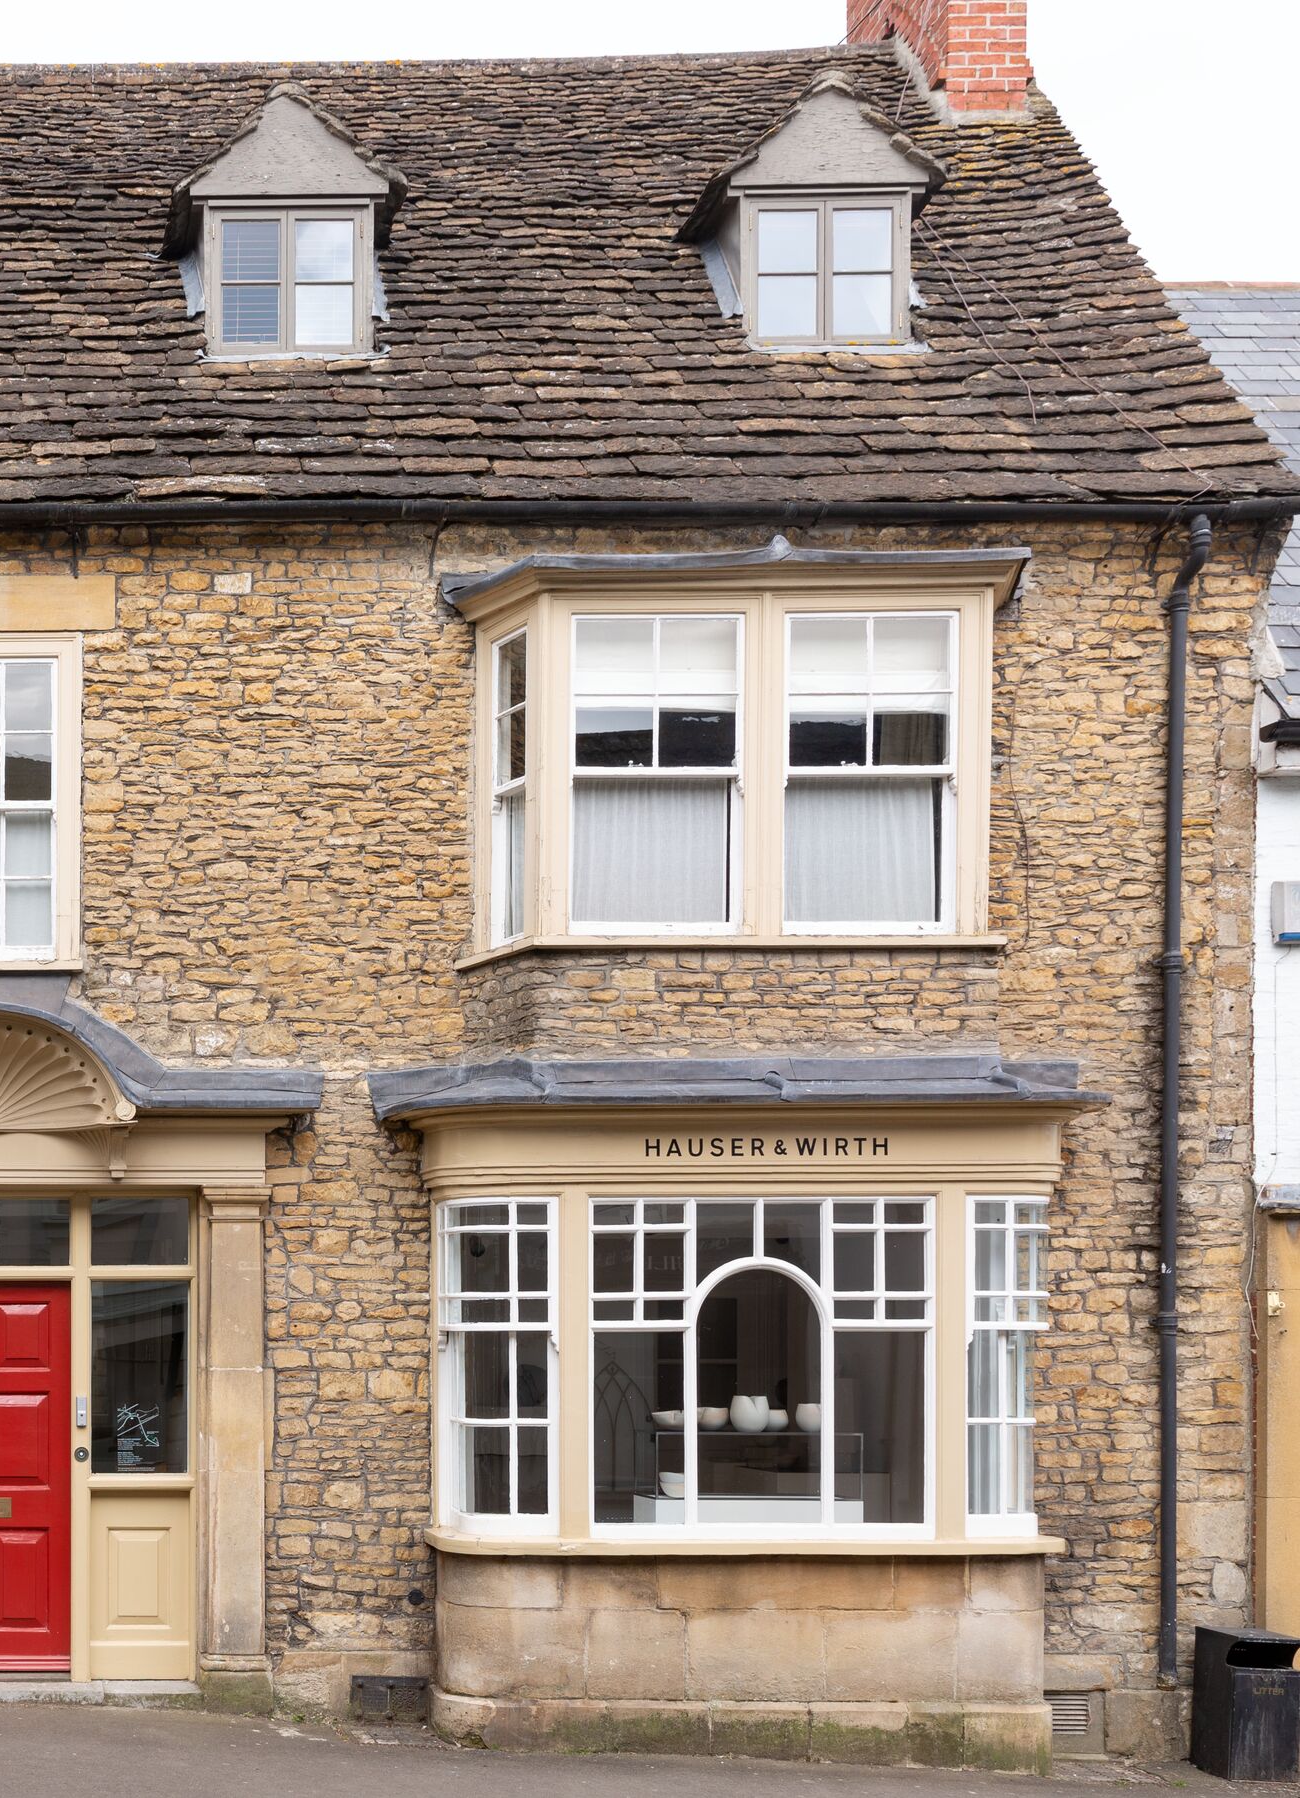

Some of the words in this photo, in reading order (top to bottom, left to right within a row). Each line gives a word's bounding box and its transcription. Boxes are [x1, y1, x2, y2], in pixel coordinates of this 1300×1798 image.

[645, 1137, 765, 1157] HAUSER
[774, 1139, 788, 1156] &
[795, 1137, 889, 1156] WIRTH
[1252, 1687, 1285, 1696] LITTER
